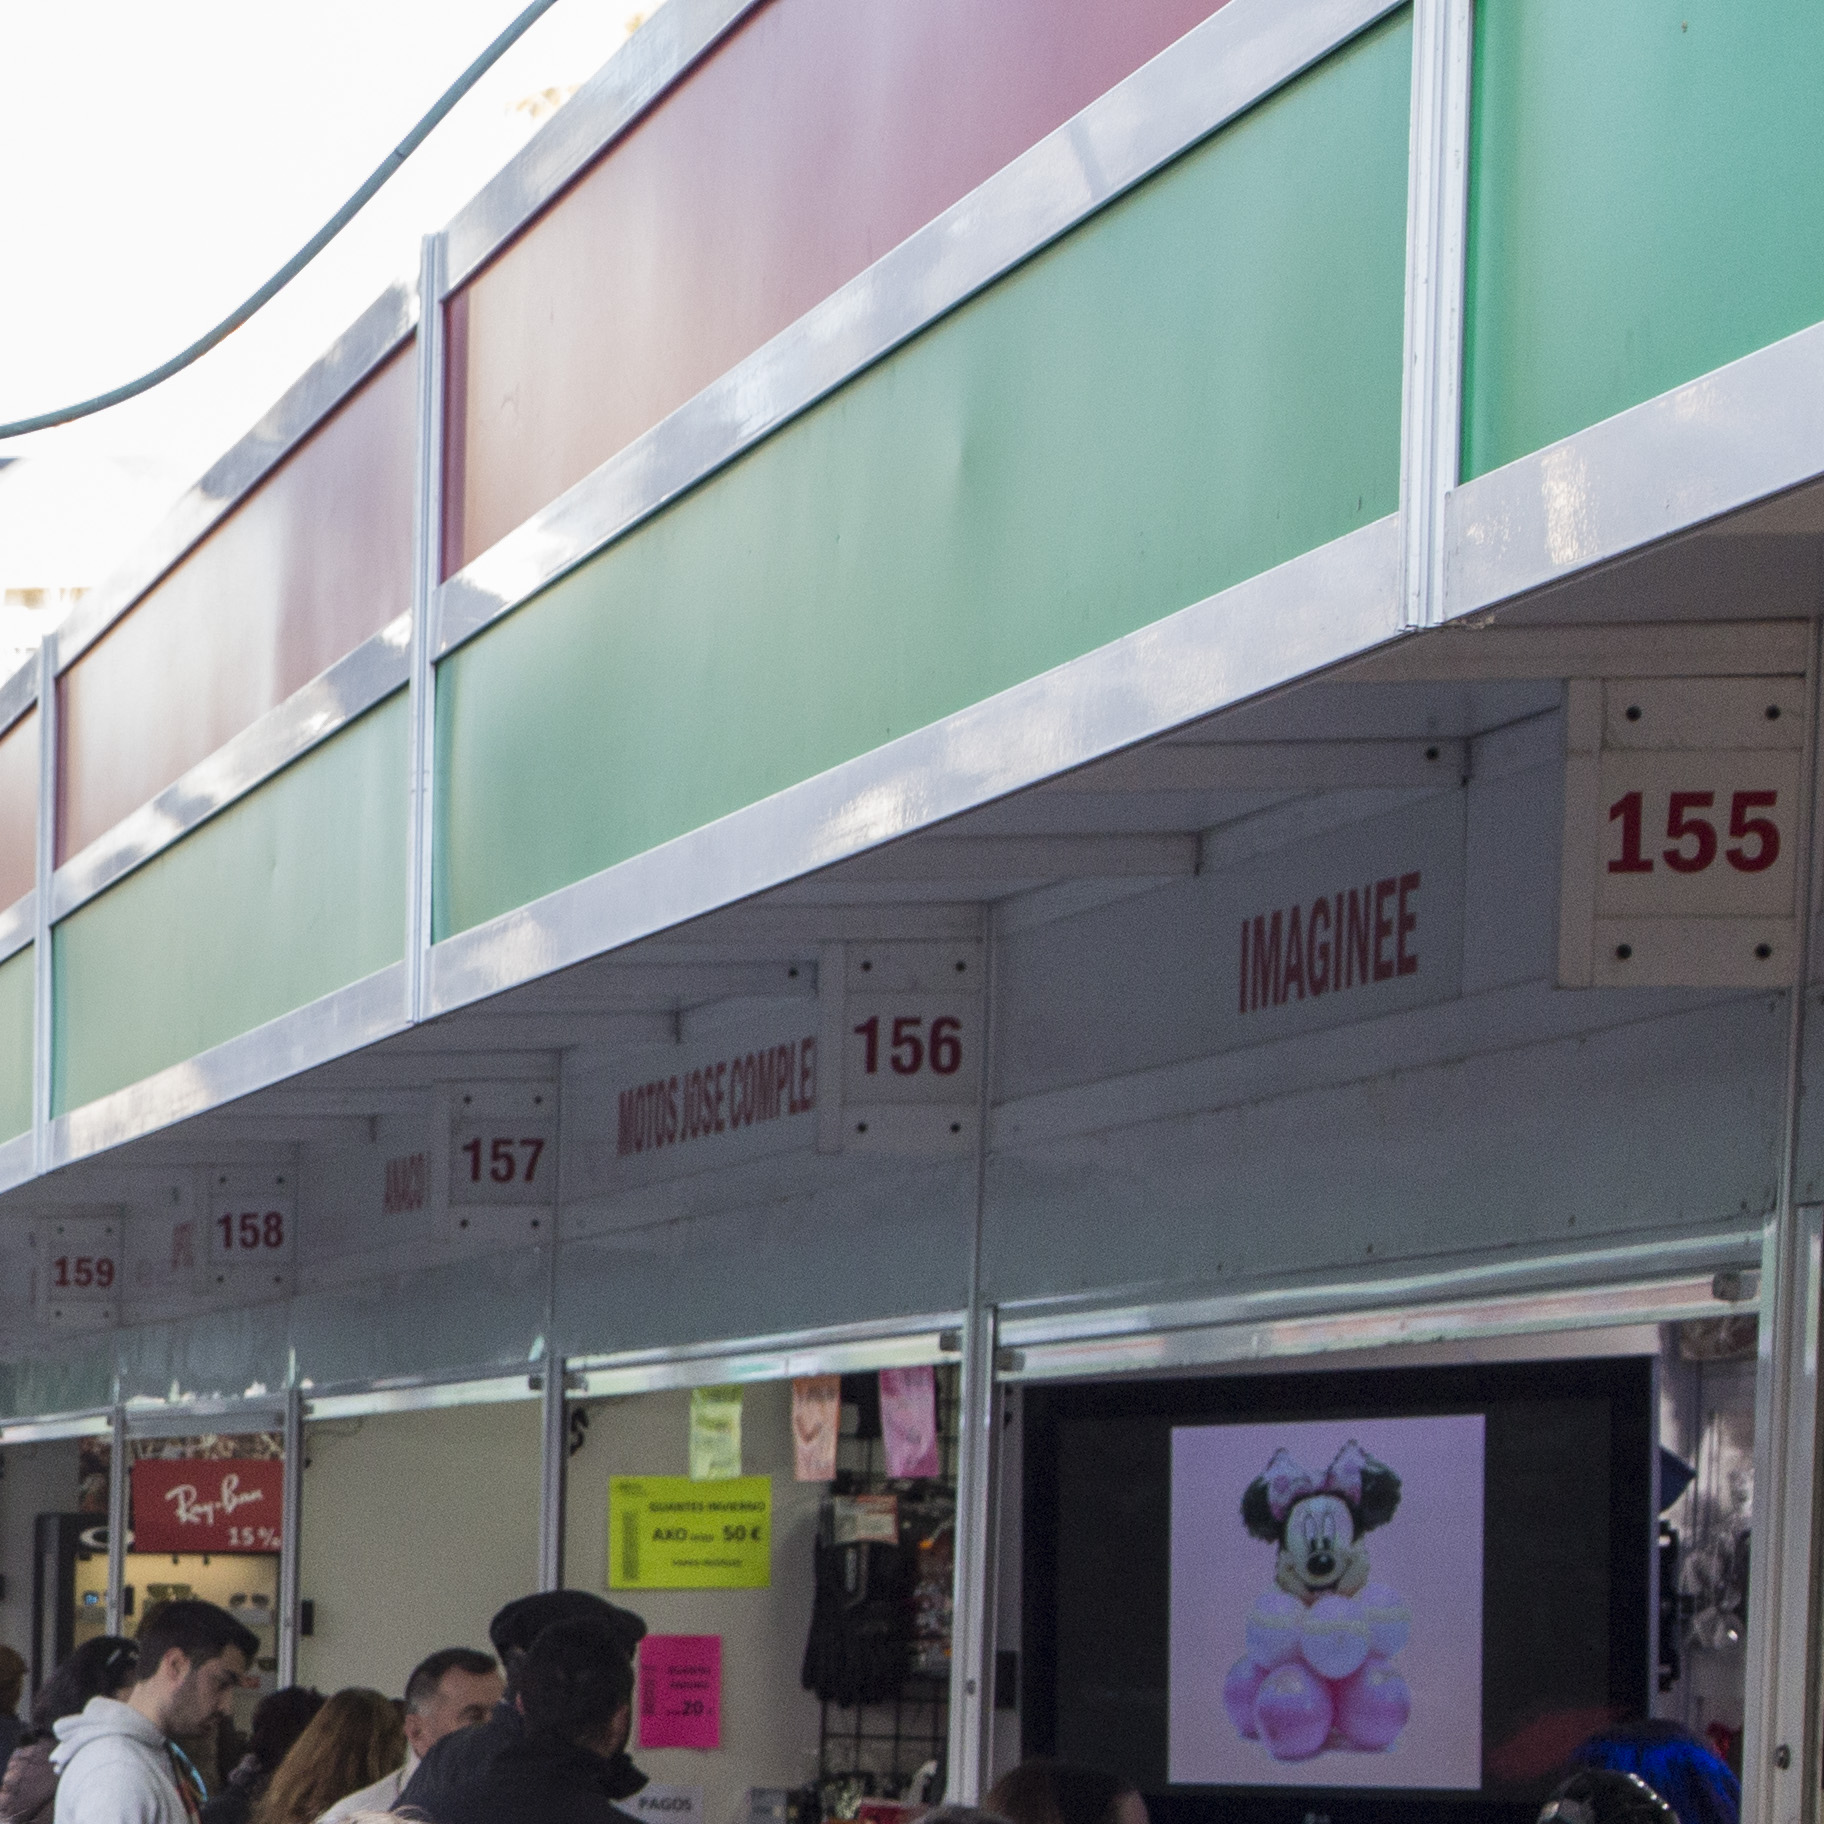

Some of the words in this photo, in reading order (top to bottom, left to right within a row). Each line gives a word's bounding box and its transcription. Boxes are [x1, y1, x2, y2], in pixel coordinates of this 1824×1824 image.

[1606, 790, 1782, 875] 155
[1238, 871, 1422, 1014] IMAGINEE
[854, 1015, 963, 1076] 156
[616, 1074, 679, 1157] MOTOS
[682, 1060, 727, 1143] JOSE
[462, 1137, 545, 1184] 157
[217, 1210, 285, 1250] 158
[53, 1255, 116, 1289] 159
[164, 1473, 264, 1527] Ray-Ban
[722, 1524, 747, 1542] 50
[638, 1796, 692, 1811] PAGOS
